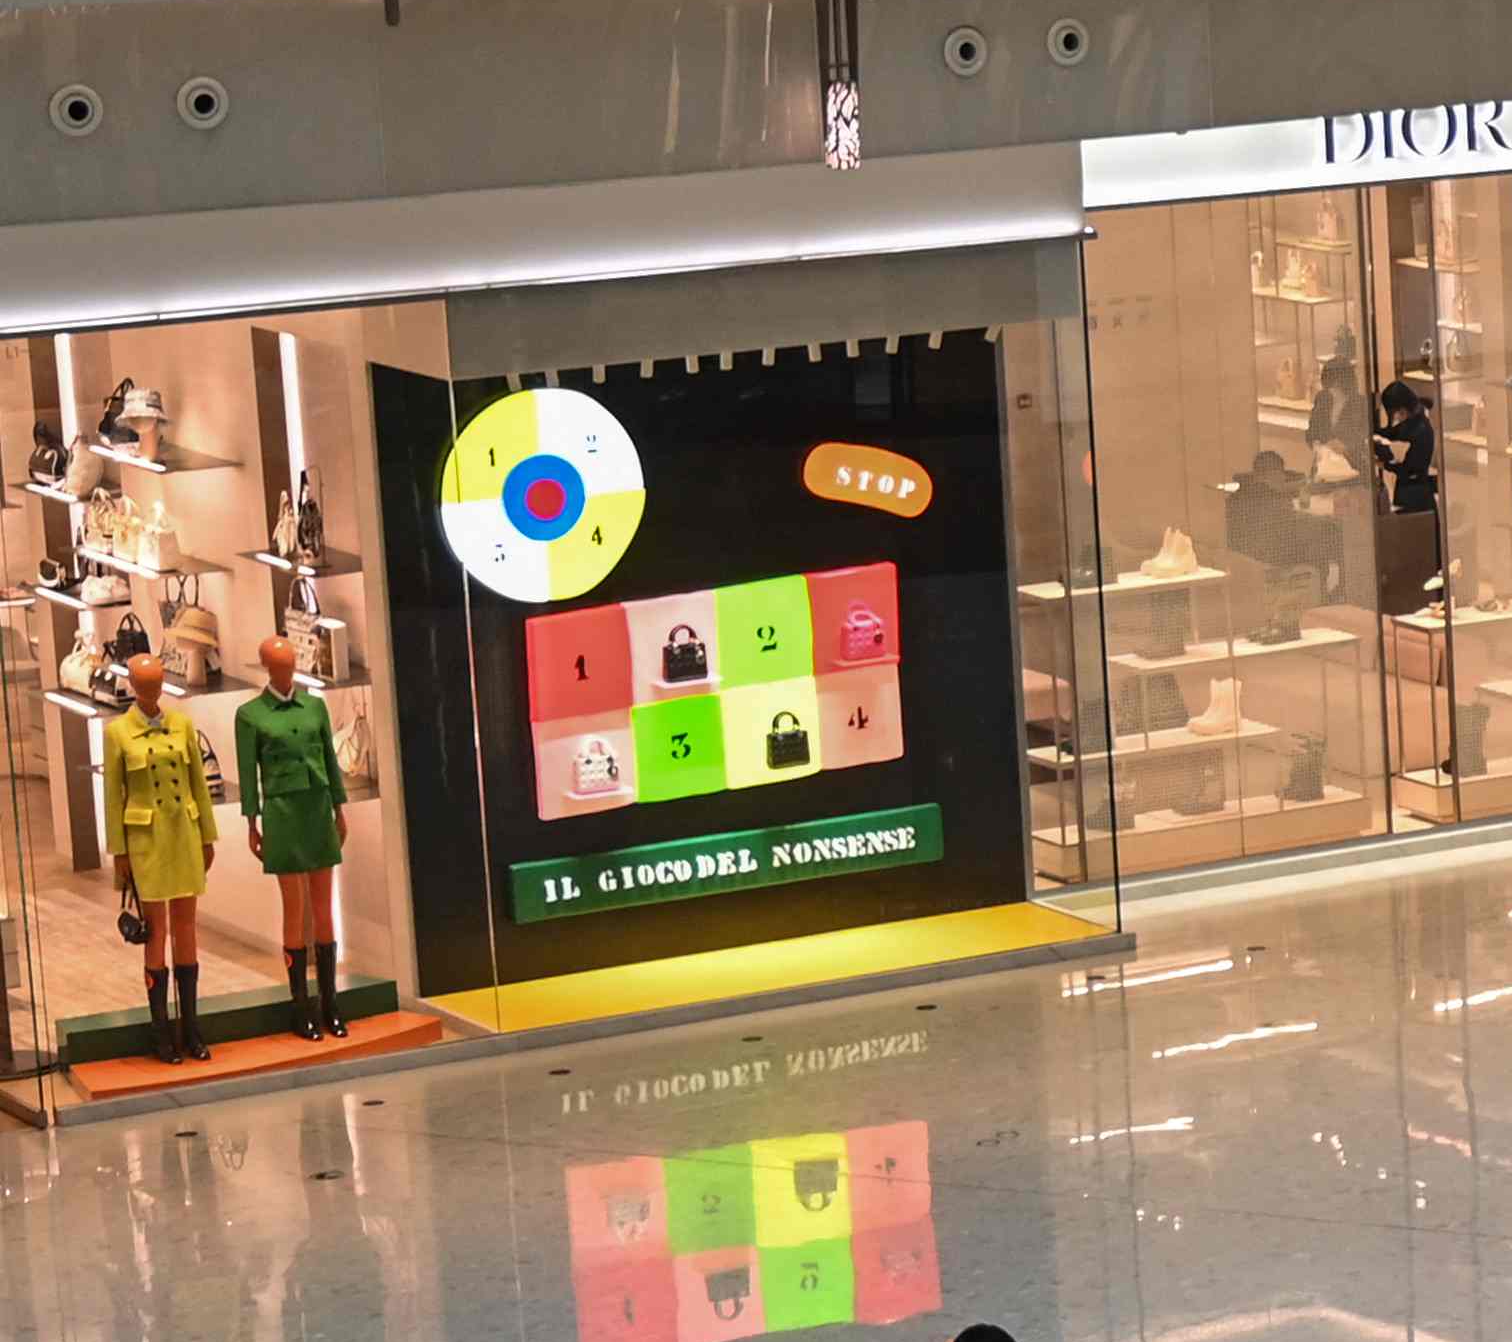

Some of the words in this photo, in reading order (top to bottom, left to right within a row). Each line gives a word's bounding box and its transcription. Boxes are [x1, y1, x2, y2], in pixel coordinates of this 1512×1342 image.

[836, 466, 919, 501] STOP
[591, 525, 603, 546] 4
[574, 652, 588, 682] 1
[755, 624, 779, 652] 2
[668, 729, 692, 763] 3
[846, 703, 871, 731] 4
[543, 877, 581, 903] IL
[772, 826, 916, 867] NONSENSE
